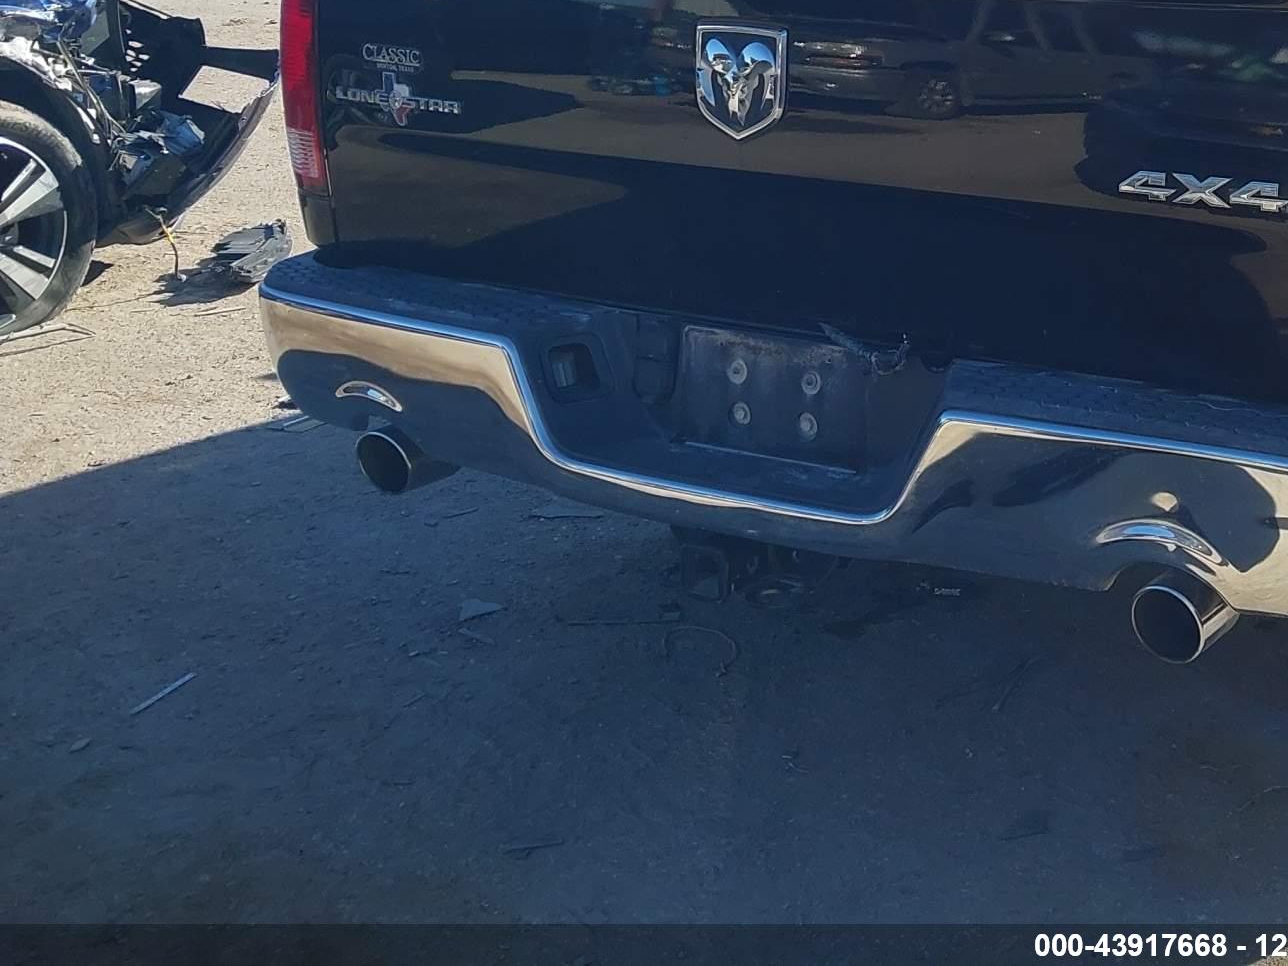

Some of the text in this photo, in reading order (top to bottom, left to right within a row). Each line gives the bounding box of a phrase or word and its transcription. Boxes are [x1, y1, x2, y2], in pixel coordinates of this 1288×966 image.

[362, 43, 420, 65] CLASSIC
[335, 86, 462, 115] LONE STAR
